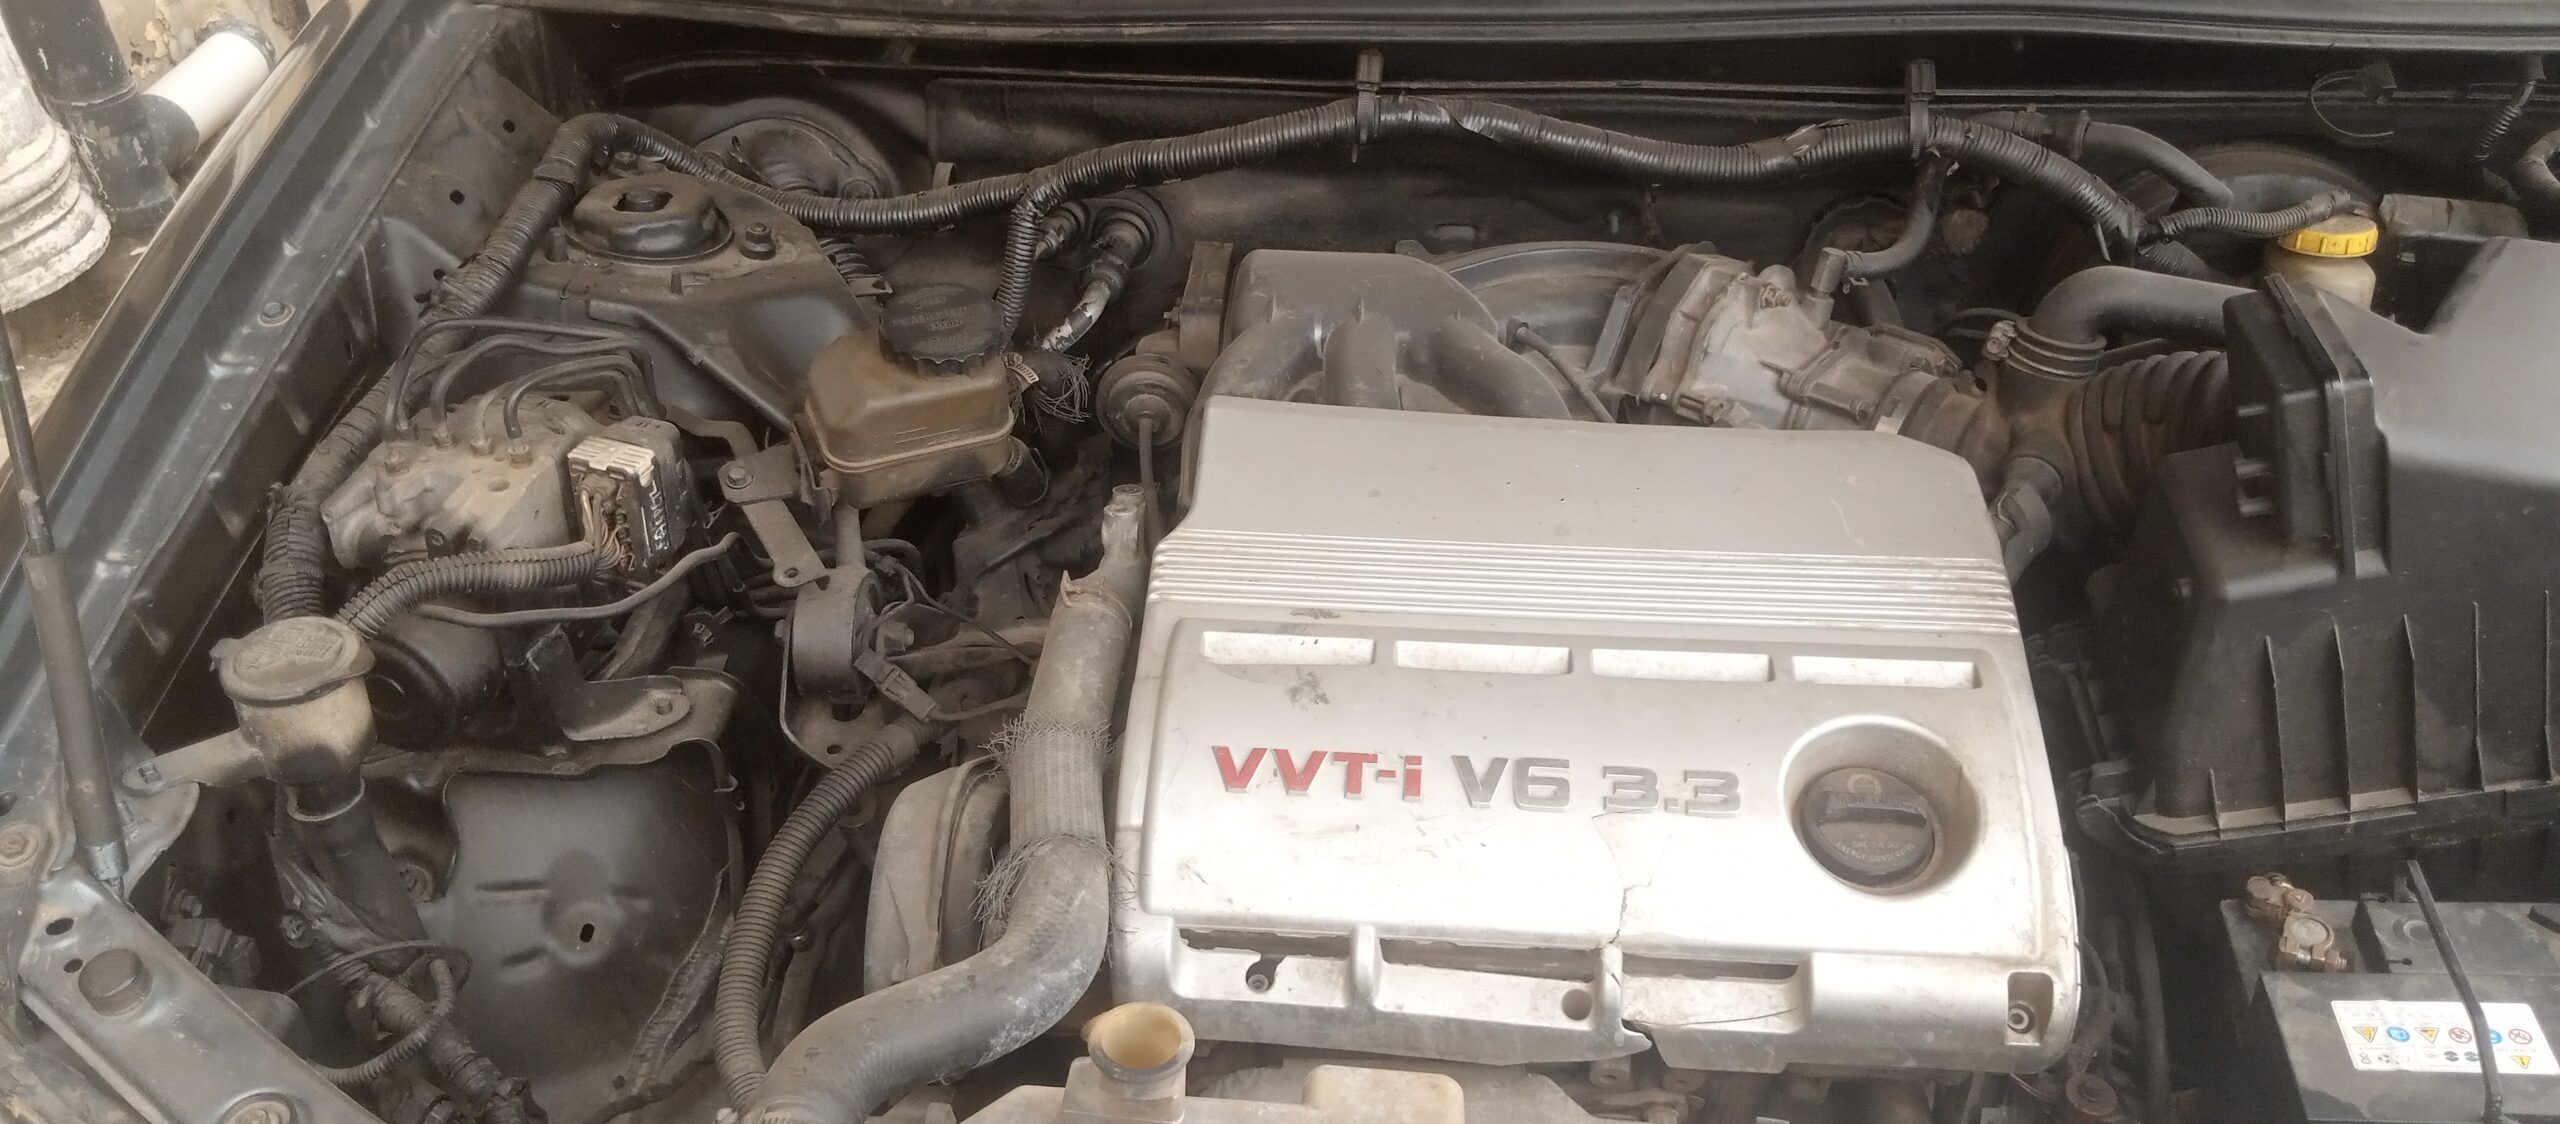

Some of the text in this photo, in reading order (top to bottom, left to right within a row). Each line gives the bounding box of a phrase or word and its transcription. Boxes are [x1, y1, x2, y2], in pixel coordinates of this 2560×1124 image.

[1211, 745, 1742, 818] VVT-i V6 3.3
